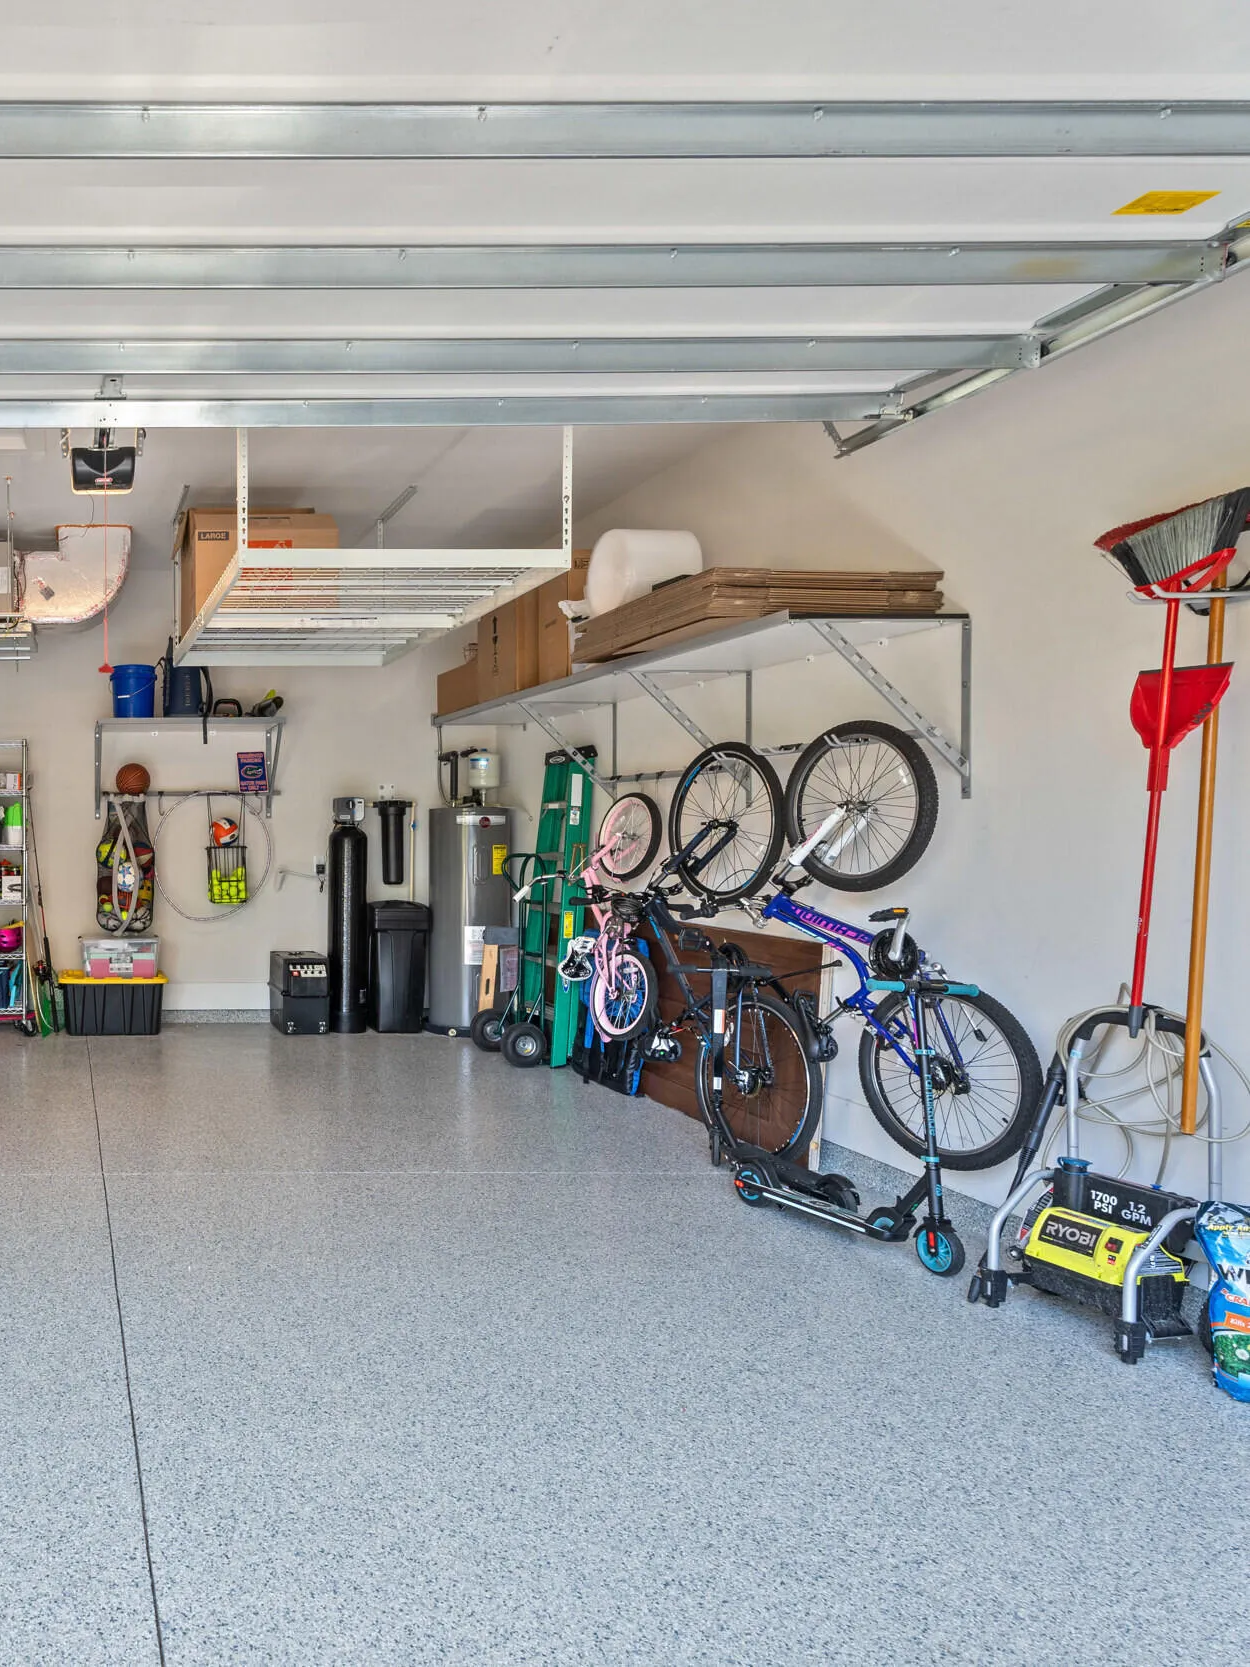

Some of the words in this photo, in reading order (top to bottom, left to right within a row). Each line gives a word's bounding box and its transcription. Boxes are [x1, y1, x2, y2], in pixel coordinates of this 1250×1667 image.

[1090, 1190, 1118, 1206] 1700
[1093, 1200, 1113, 1214] PSI
[1128, 1201, 1146, 1215] 1.2
[1121, 1209, 1152, 1227] GPM
[1045, 1221, 1097, 1248] RYOBI
